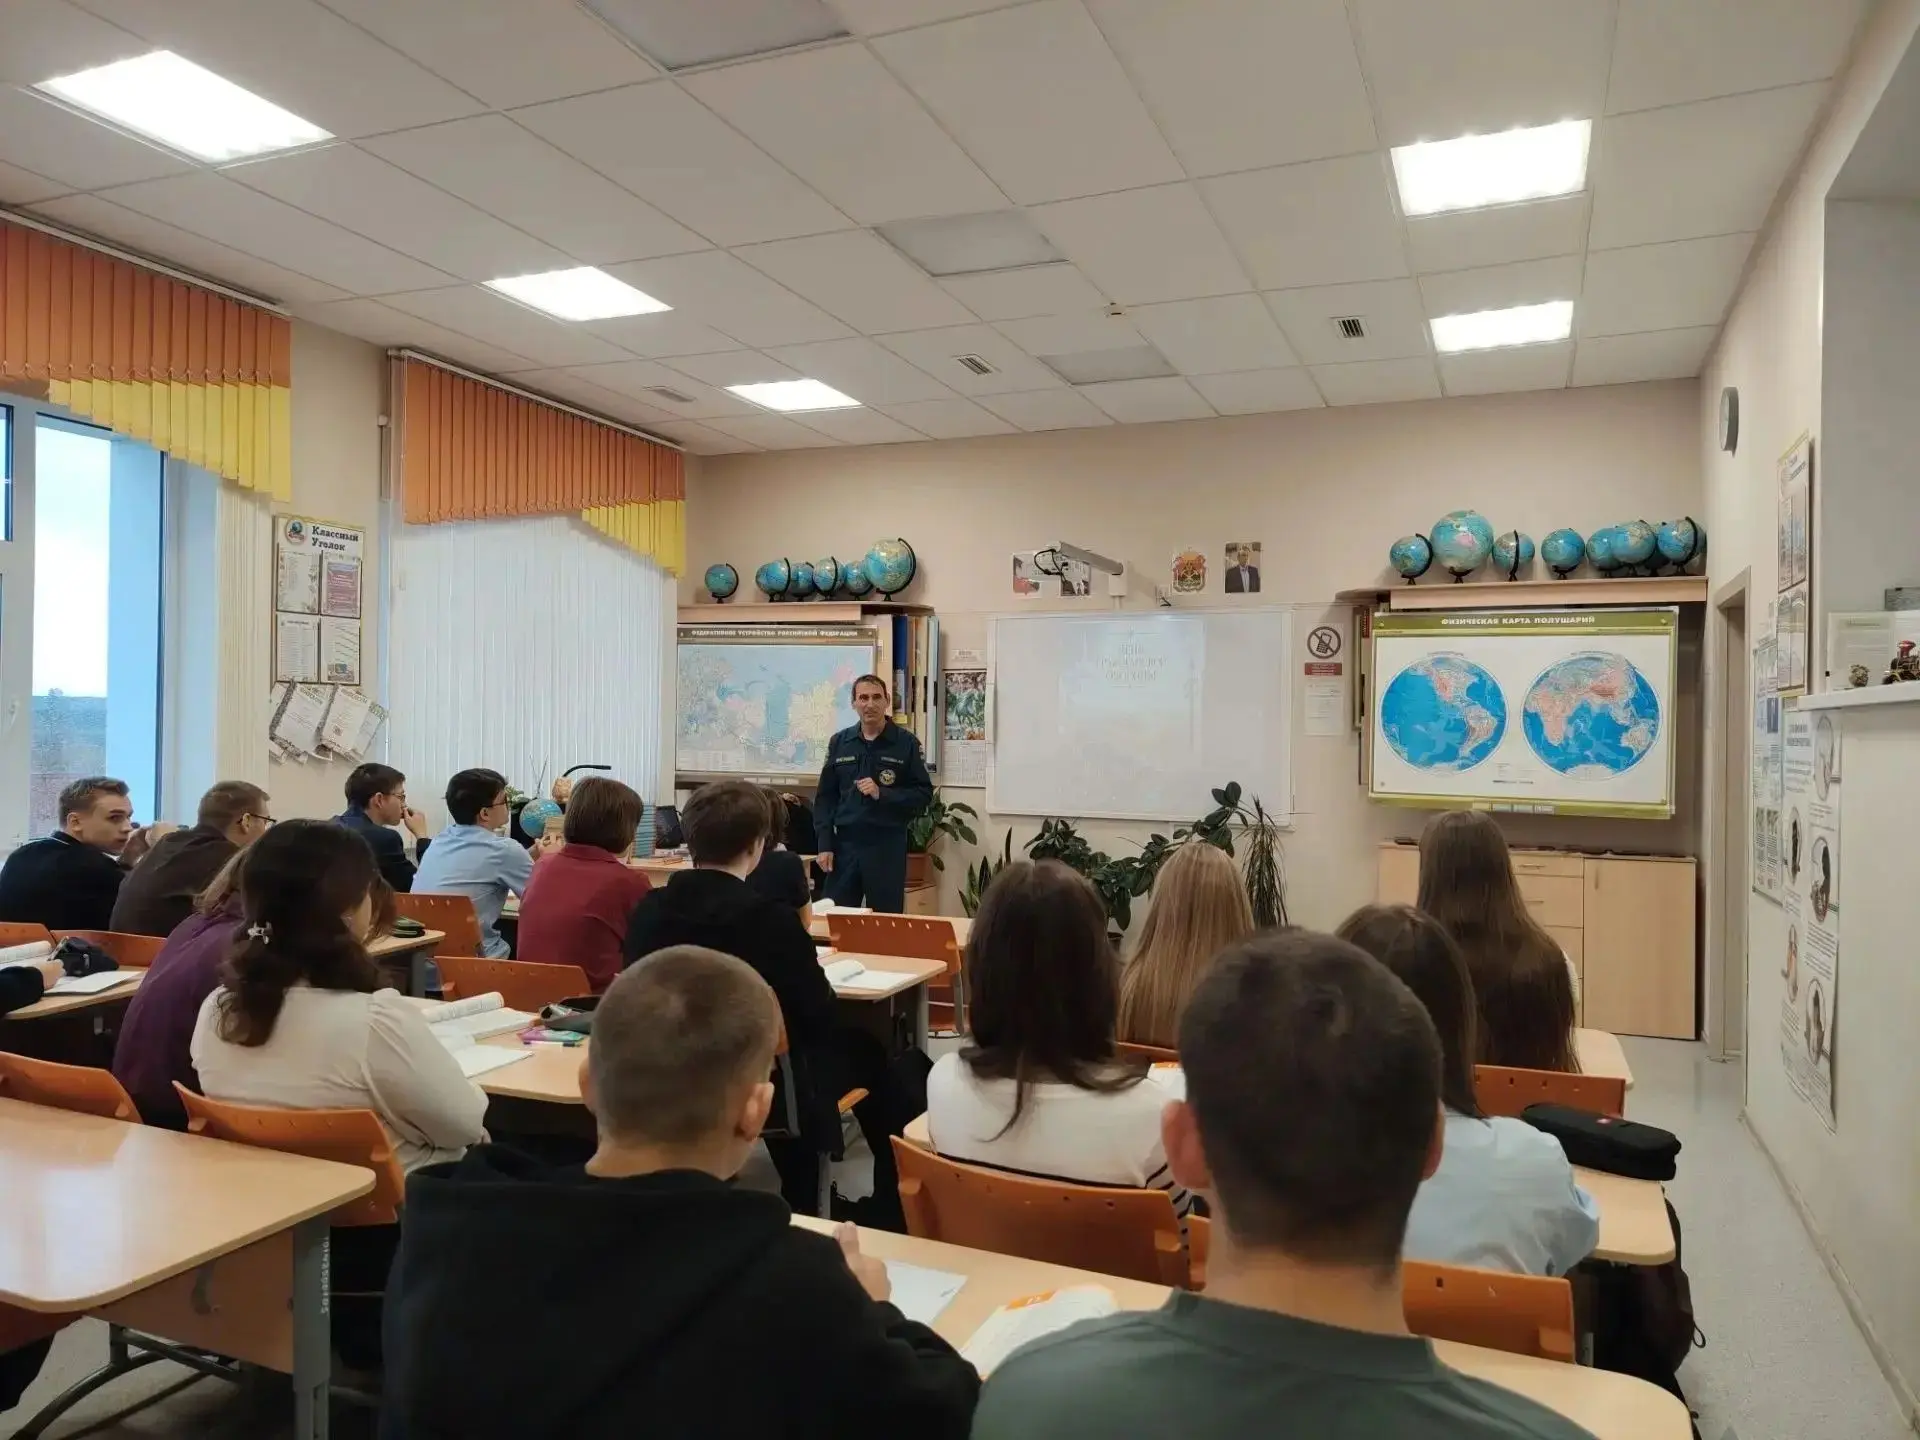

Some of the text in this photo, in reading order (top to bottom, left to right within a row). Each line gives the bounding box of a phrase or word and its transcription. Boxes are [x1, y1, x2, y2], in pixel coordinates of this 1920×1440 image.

[311, 537, 346, 551] Уголок
[1502, 617, 1531, 625] КАРТА
[1534, 616, 1595, 624] ПОЛУШАРИЙ
